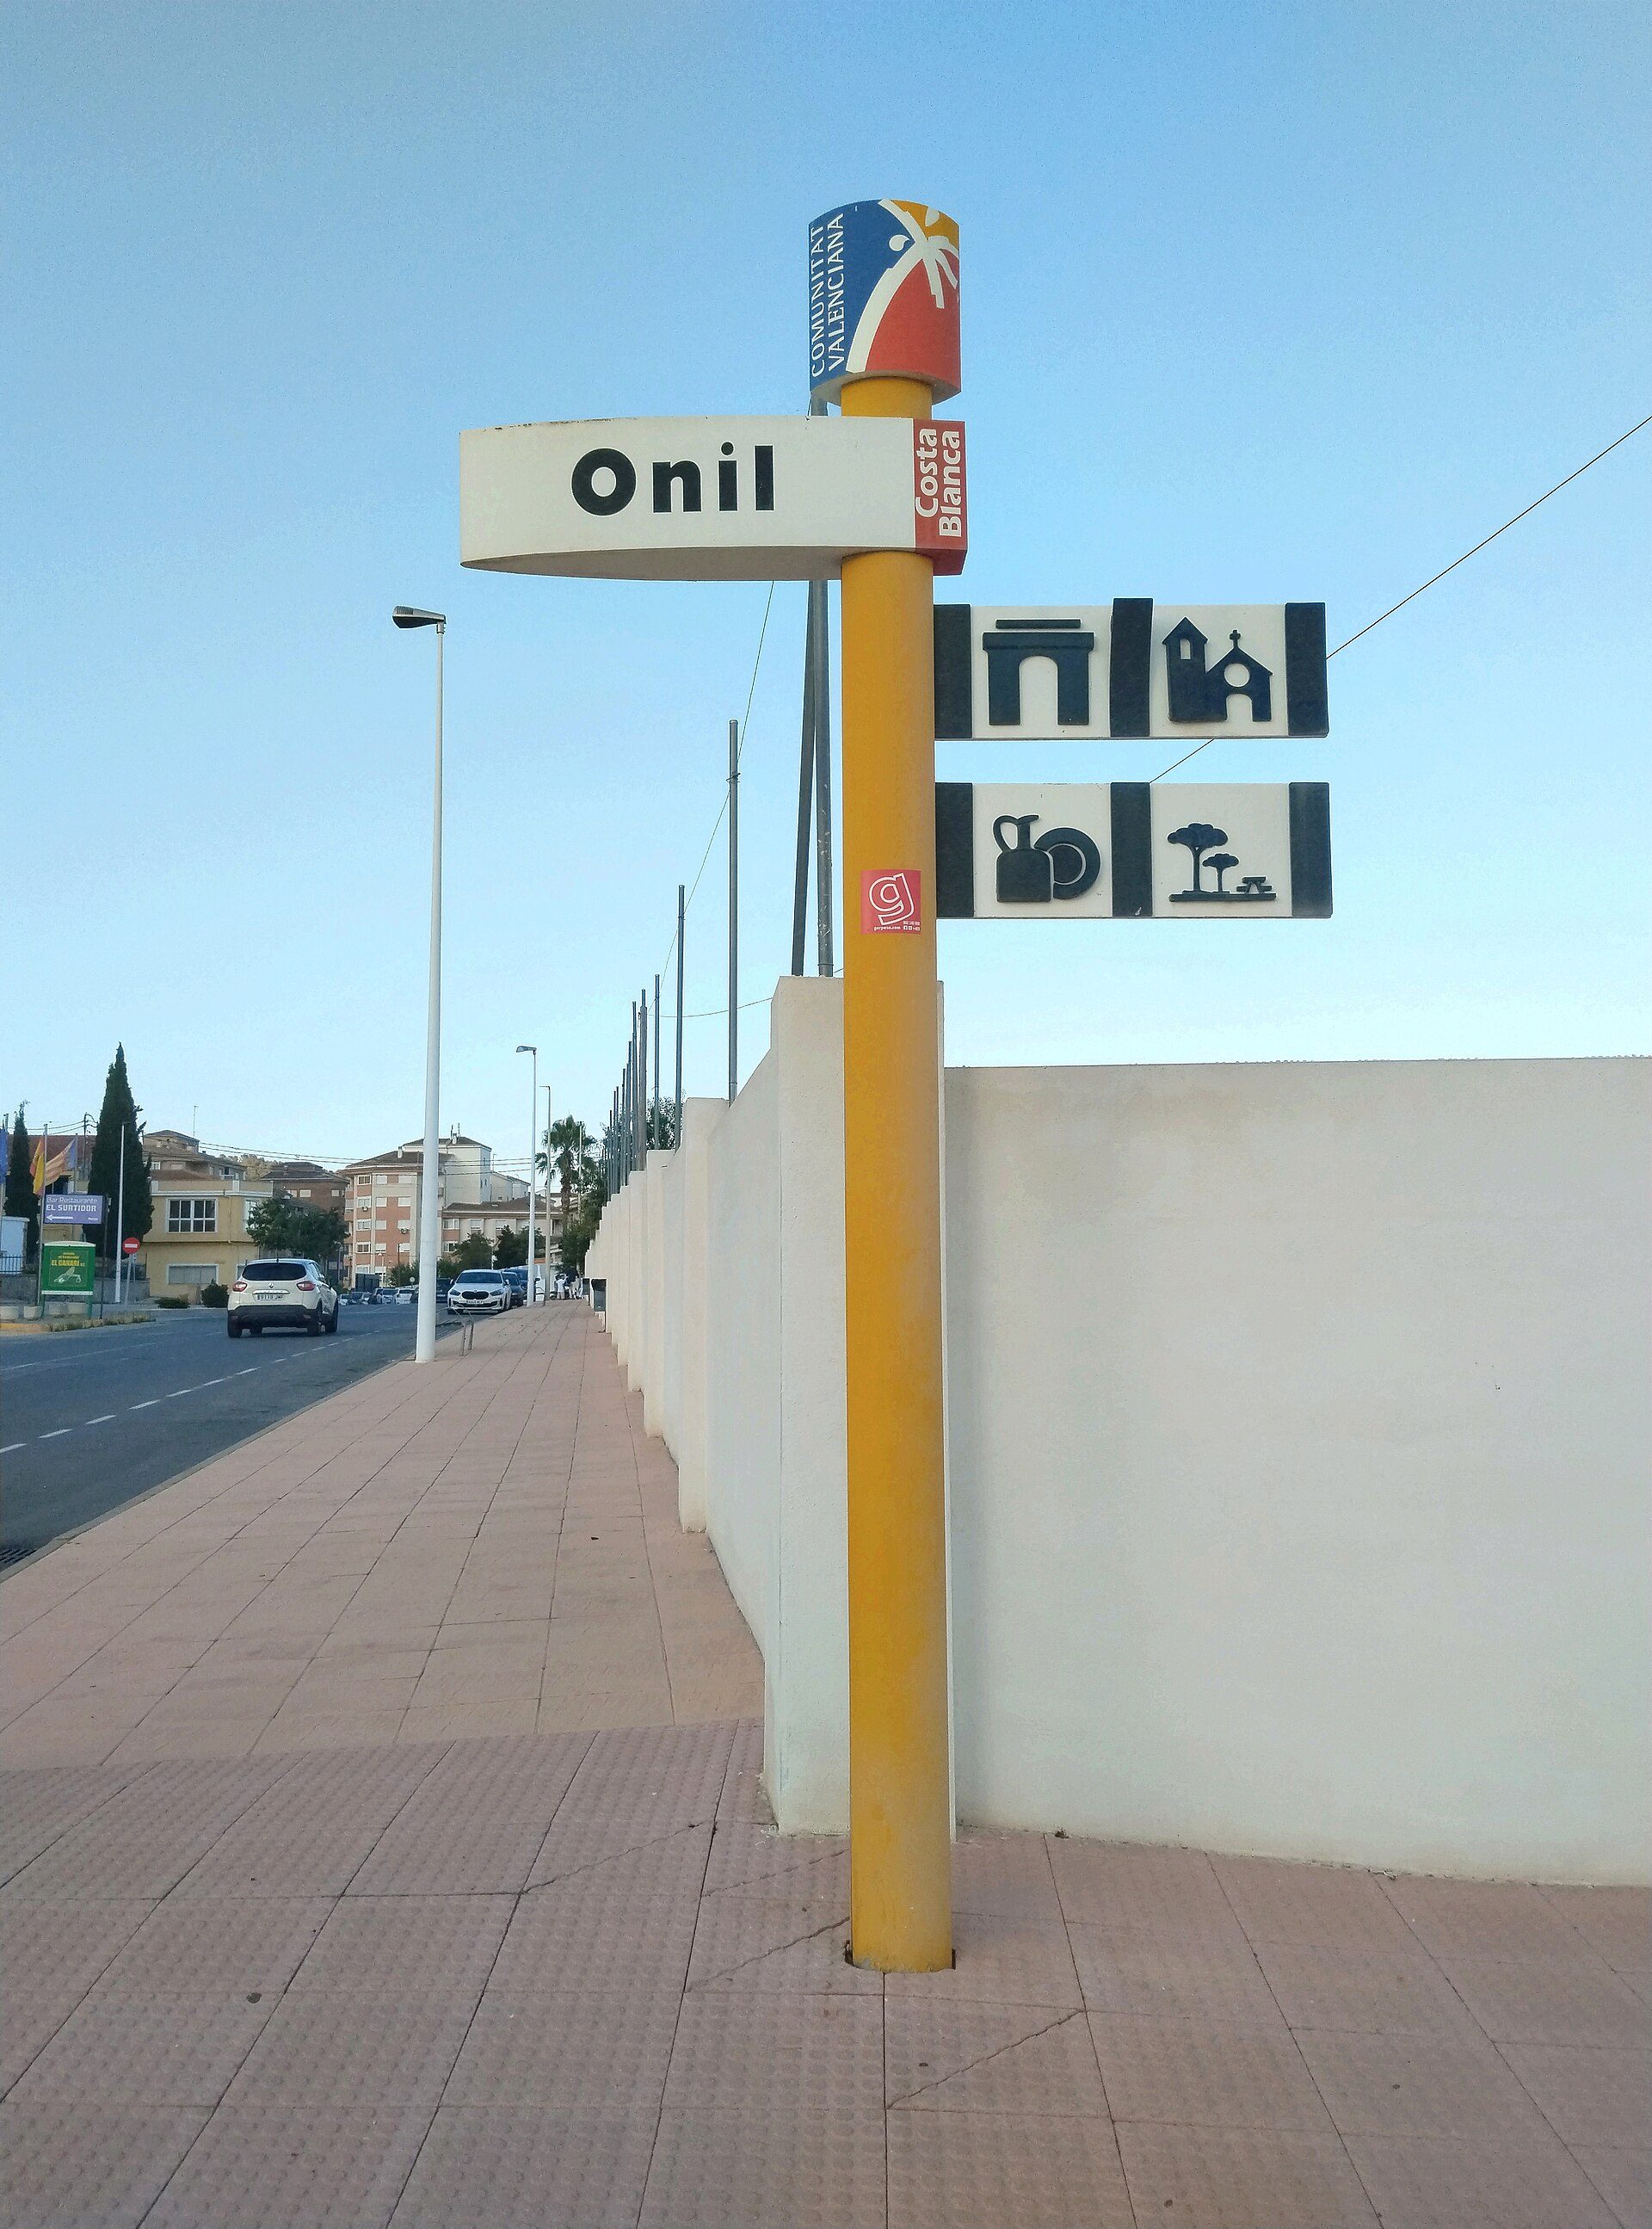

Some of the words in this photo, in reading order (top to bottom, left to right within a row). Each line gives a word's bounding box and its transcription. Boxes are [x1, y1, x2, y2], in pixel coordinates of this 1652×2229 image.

[811, 225, 825, 378] COMUNITAT
[827, 213, 845, 372] VALENCIANA
[570, 441, 775, 516] Onil
[915, 428, 939, 518] Costa
[939, 430, 962, 538] Blanca
